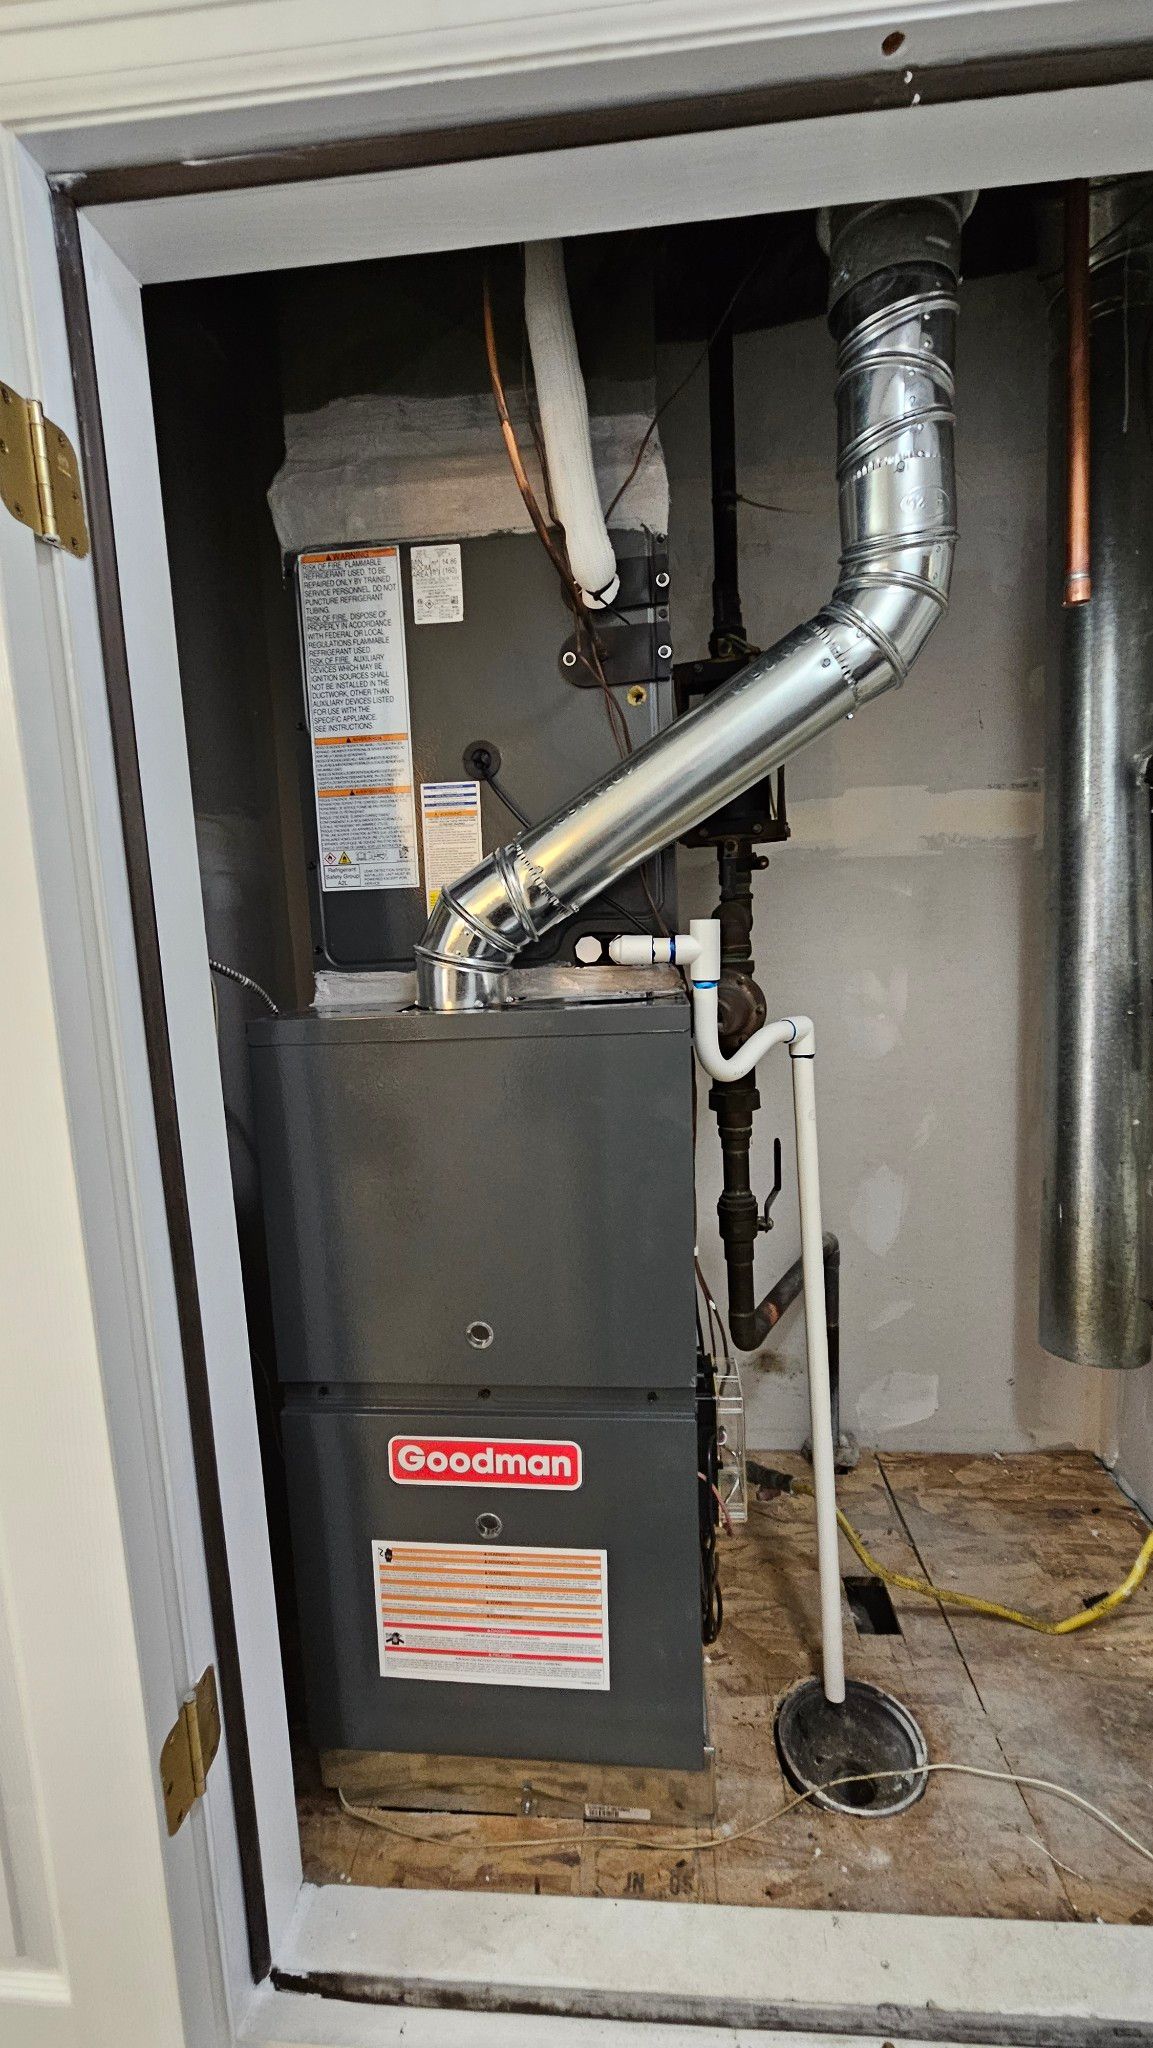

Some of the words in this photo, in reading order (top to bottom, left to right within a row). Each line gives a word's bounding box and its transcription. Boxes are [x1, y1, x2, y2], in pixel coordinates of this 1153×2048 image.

[333, 552, 369, 560] WARNING
[344, 559, 381, 567] FLAMMABLE
[304, 570, 346, 579] REFRIGERANT
[304, 580, 334, 588] REPAIRED
[364, 575, 391, 583] TRAINED
[305, 589, 330, 597] SERVICE
[305, 597, 339, 606] PUNCTURE
[341, 593, 383, 603] REFRIGERANT
[350, 611, 378, 620] DISPOSE
[308, 622, 339, 631] PROPERLY
[349, 619, 391, 628] ACCORDANCE
[325, 630, 352, 638] FEDERAL
[353, 637, 390, 645] FLAMMABLE
[309, 648, 351, 657] REFRIGERANT
[353, 654, 384, 662] AUXILIARY
[311, 665, 336, 674] DEVICES
[312, 674, 338, 682] IGNITION
[339, 672, 369, 680] SOURCES
[336, 681, 368, 689] INSTALLED
[313, 699, 343, 707] AUXILIARY
[345, 697, 371, 705] DEVICES
[314, 716, 341, 724] SPECIFIC
[398, 1445, 572, 1477] Goodman
